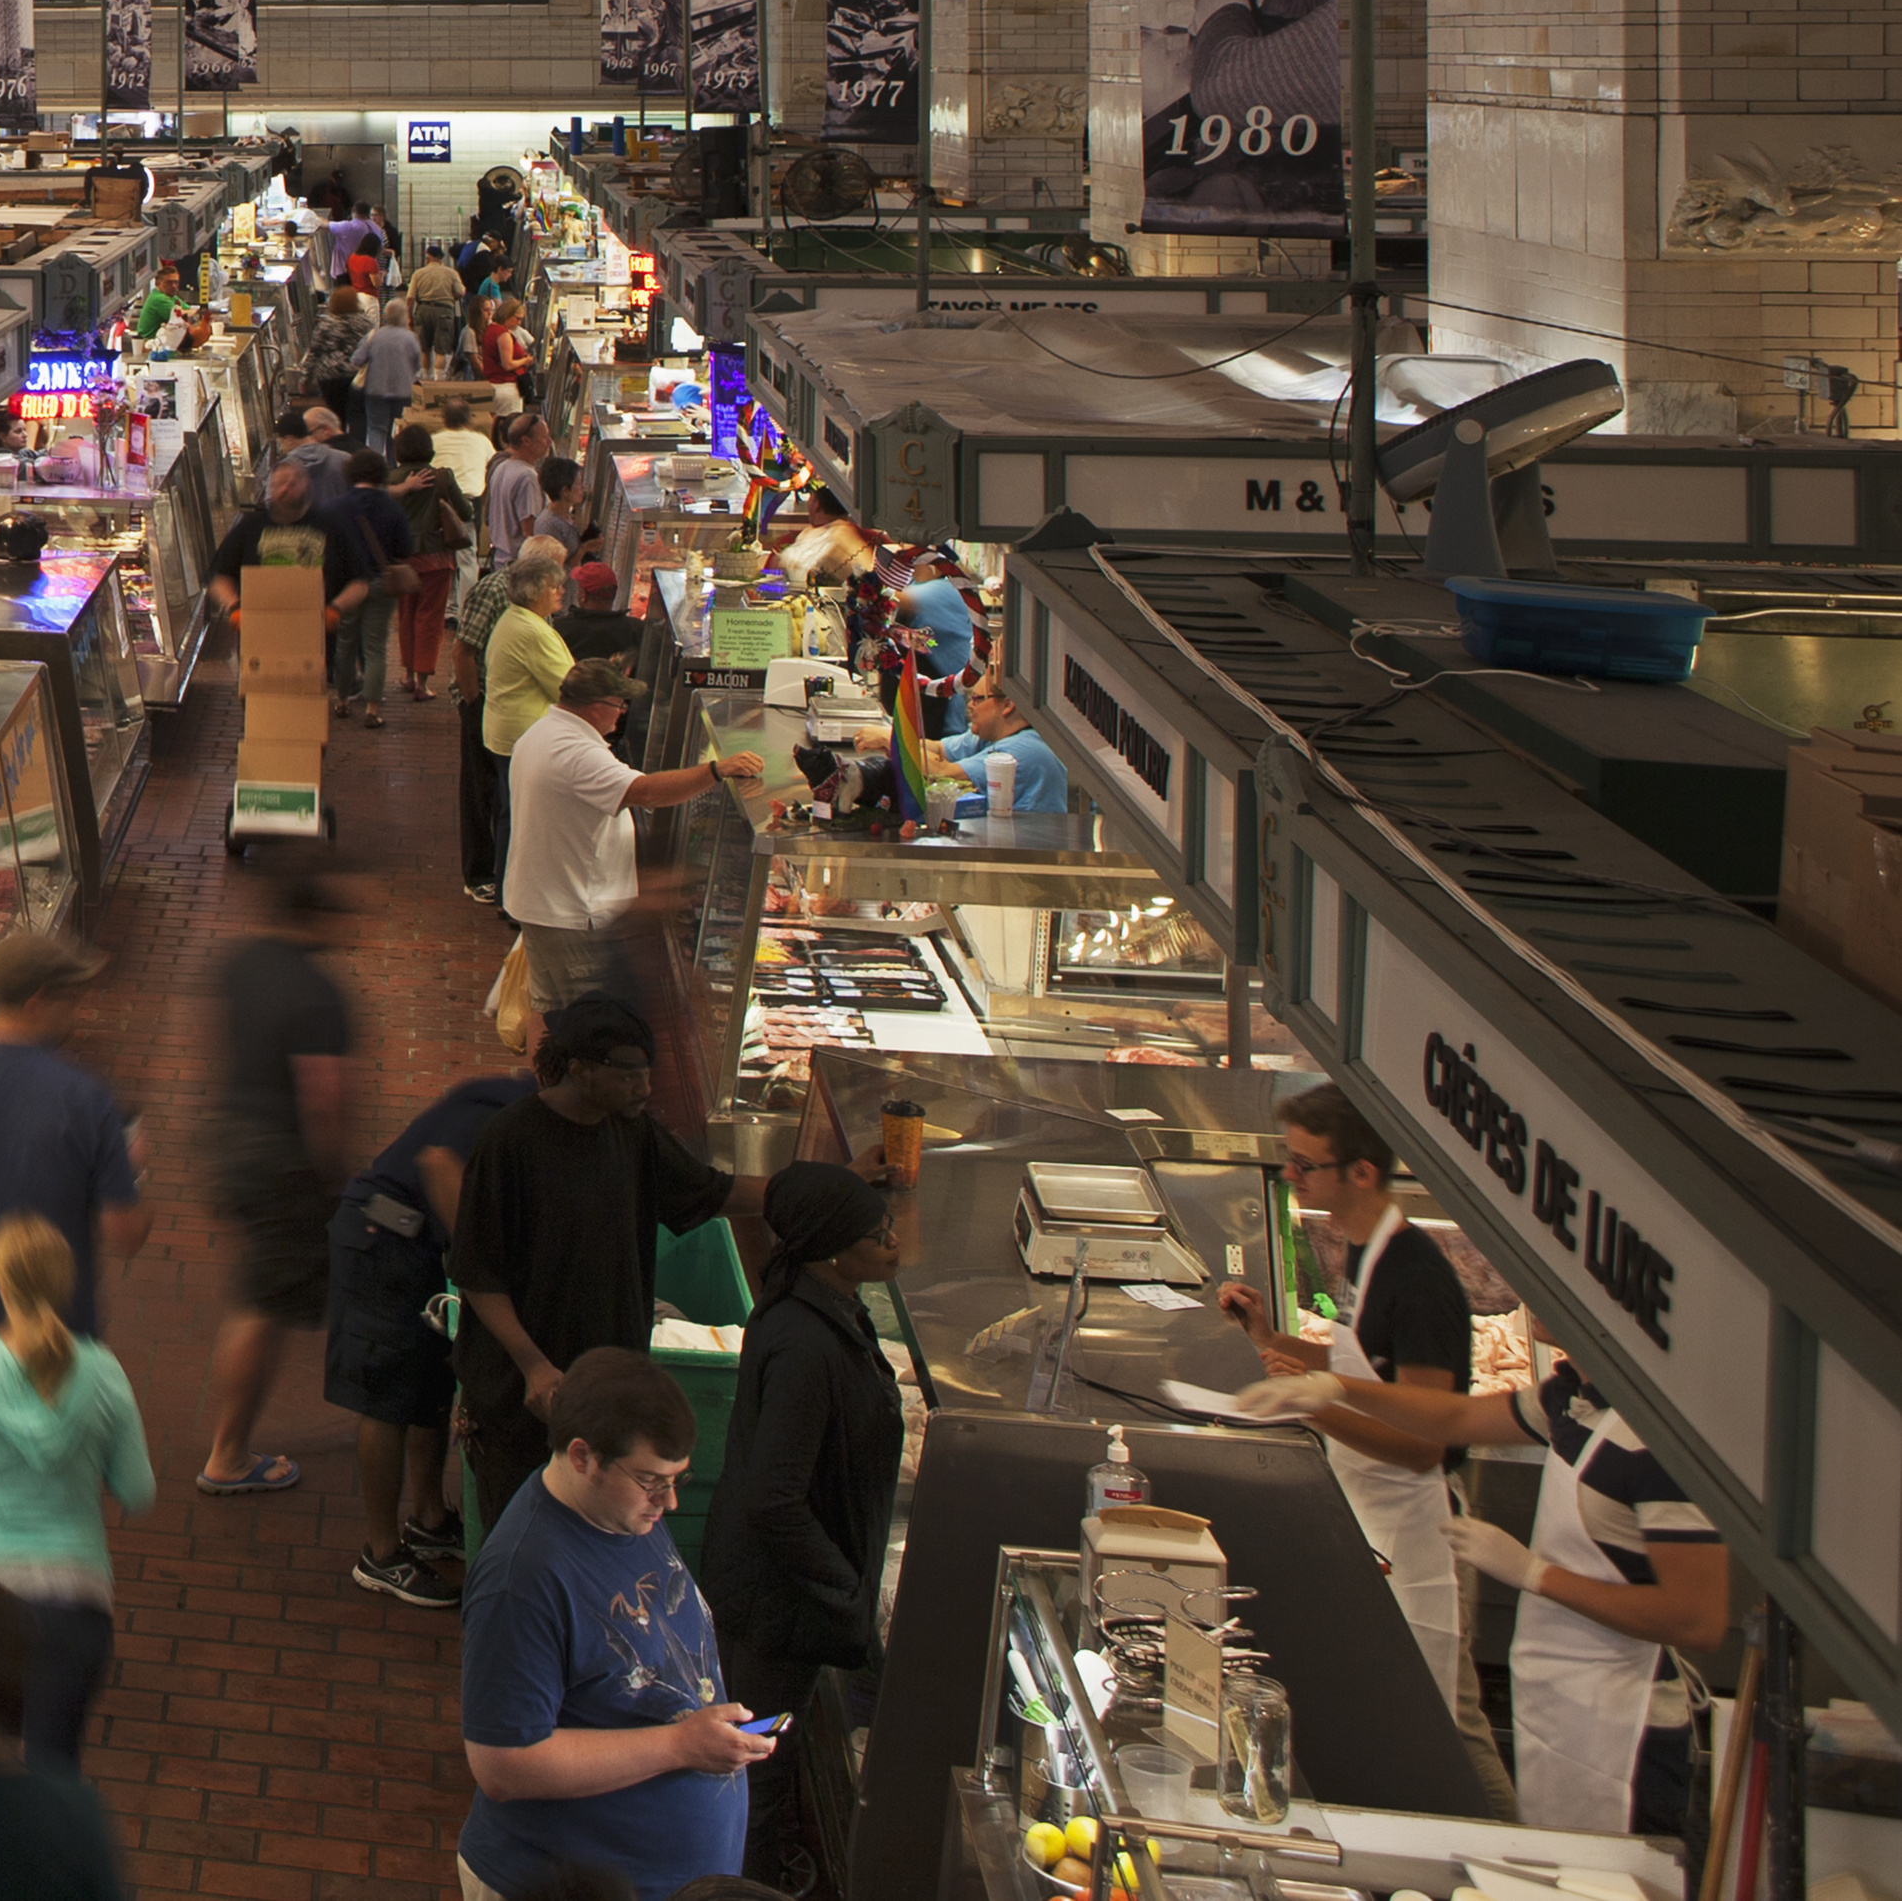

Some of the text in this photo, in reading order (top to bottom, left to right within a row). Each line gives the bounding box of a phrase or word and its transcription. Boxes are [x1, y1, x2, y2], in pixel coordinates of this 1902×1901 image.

[191, 61, 233, 75] 1966
[605, 58, 634, 71] 1962
[643, 63, 678, 79] 1967
[110, 69, 145, 89] 1972
[703, 71, 751, 89] 1975
[837, 80, 905, 107] 1977
[410, 126, 450, 141] ATM
[1164, 105, 1318, 166] 1980
[165, 218, 179, 232] D
[59, 273, 76, 294] D
[718, 281, 735, 302] C
[722, 307, 734, 329] 6
[21, 394, 59, 418] FILLED
[61, 394, 77, 418] TO
[900, 440, 927, 476] C
[903, 488, 924, 522] 4
[1245, 479, 1281, 512] M
[1295, 480, 1326, 513] &
[726, 618, 774, 627] Homemade
[707, 672, 750, 688] BACON
[1118, 707, 1171, 803] POULTRY
[1258, 811, 1277, 882] C
[1532, 1138, 1580, 1253] DE
[1584, 1189, 1674, 1352] LUXE
